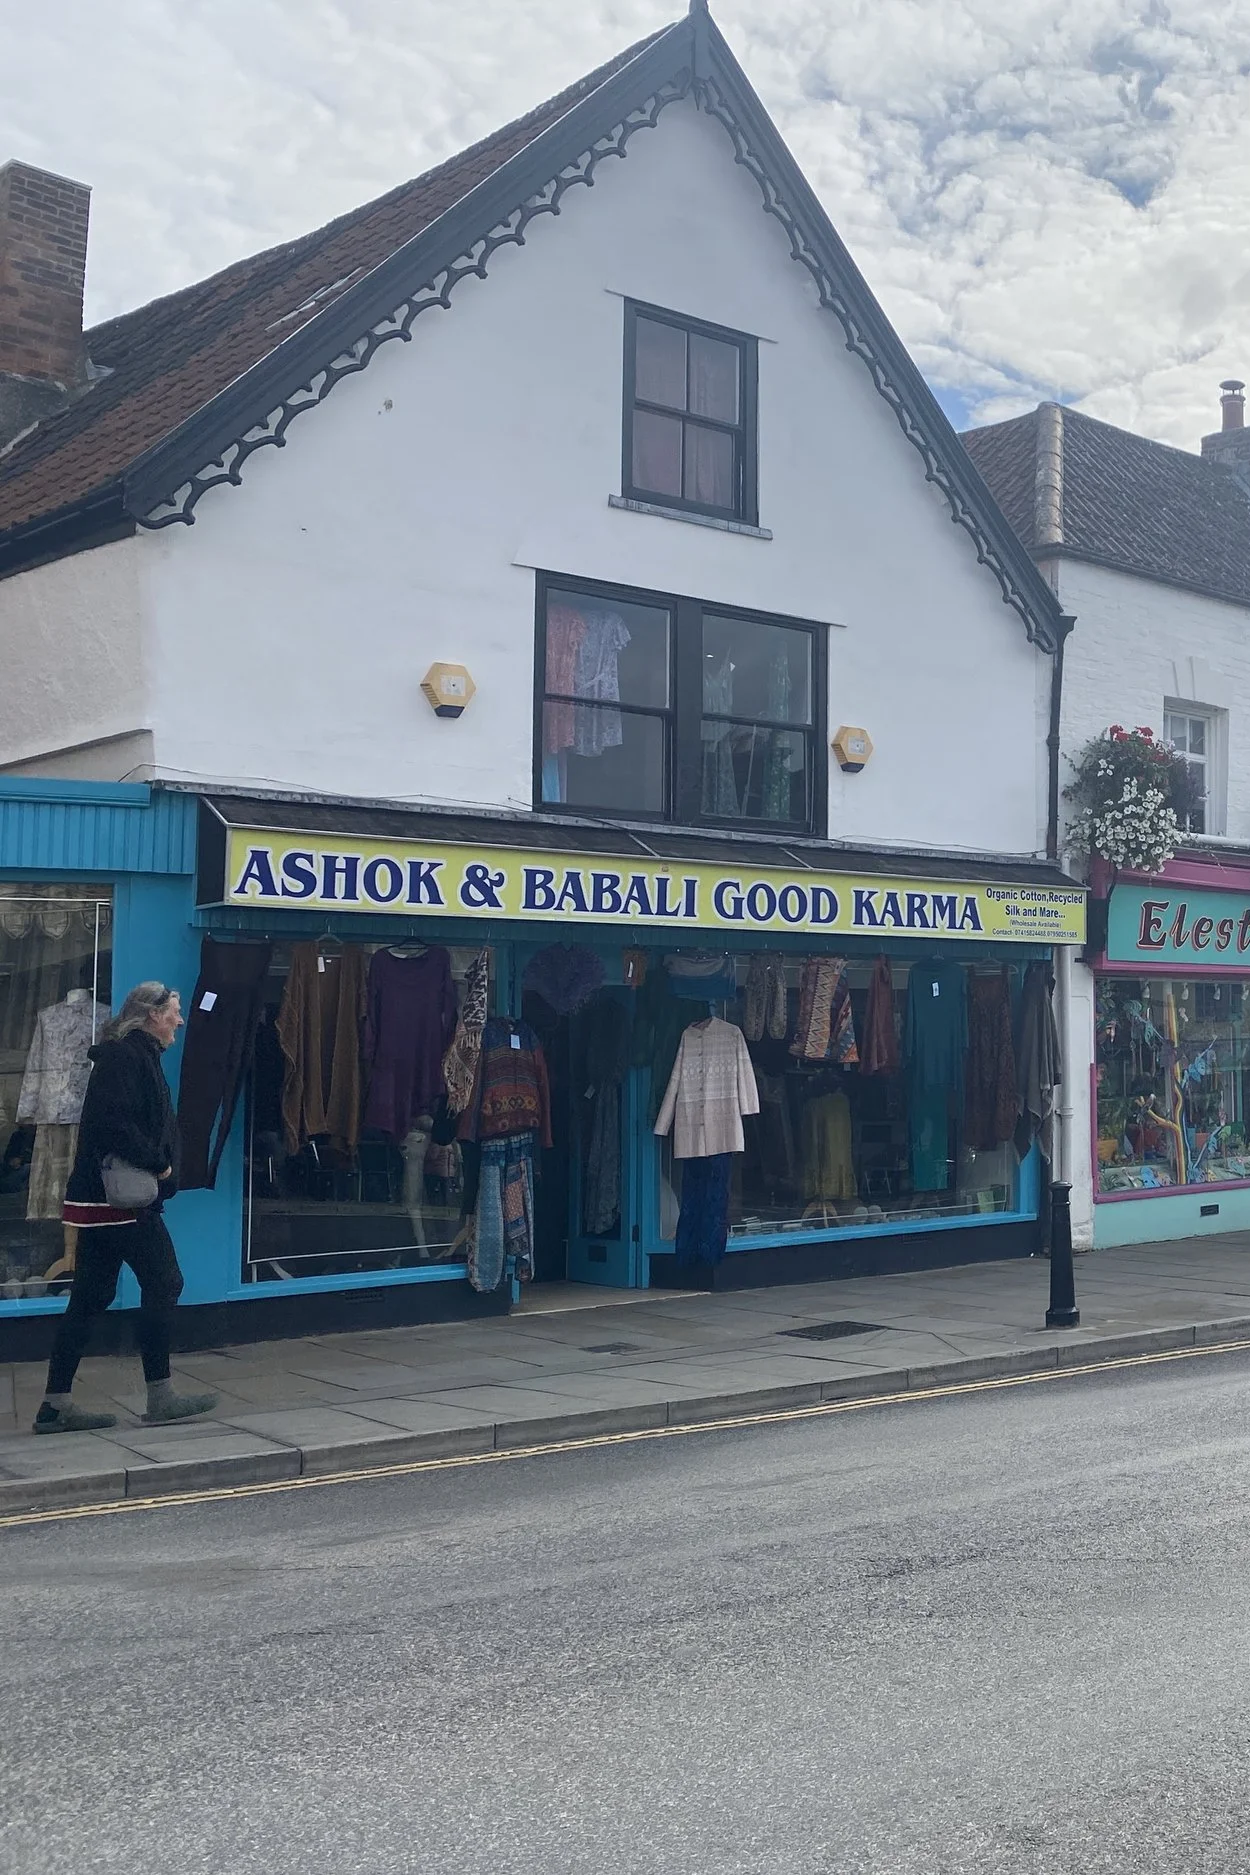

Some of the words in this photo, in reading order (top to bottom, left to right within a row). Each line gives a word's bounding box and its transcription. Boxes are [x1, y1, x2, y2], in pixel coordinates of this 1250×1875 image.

[233, 848, 445, 906] ASHOK
[460, 863, 505, 909] &
[522, 867, 699, 919] BABALI
[713, 880, 839, 924] GOOD
[852, 889, 984, 931] KARMA
[986, 887, 1018, 901] Organic
[1005, 904, 1021, 917] Silk
[1022, 906, 1037, 917] and
